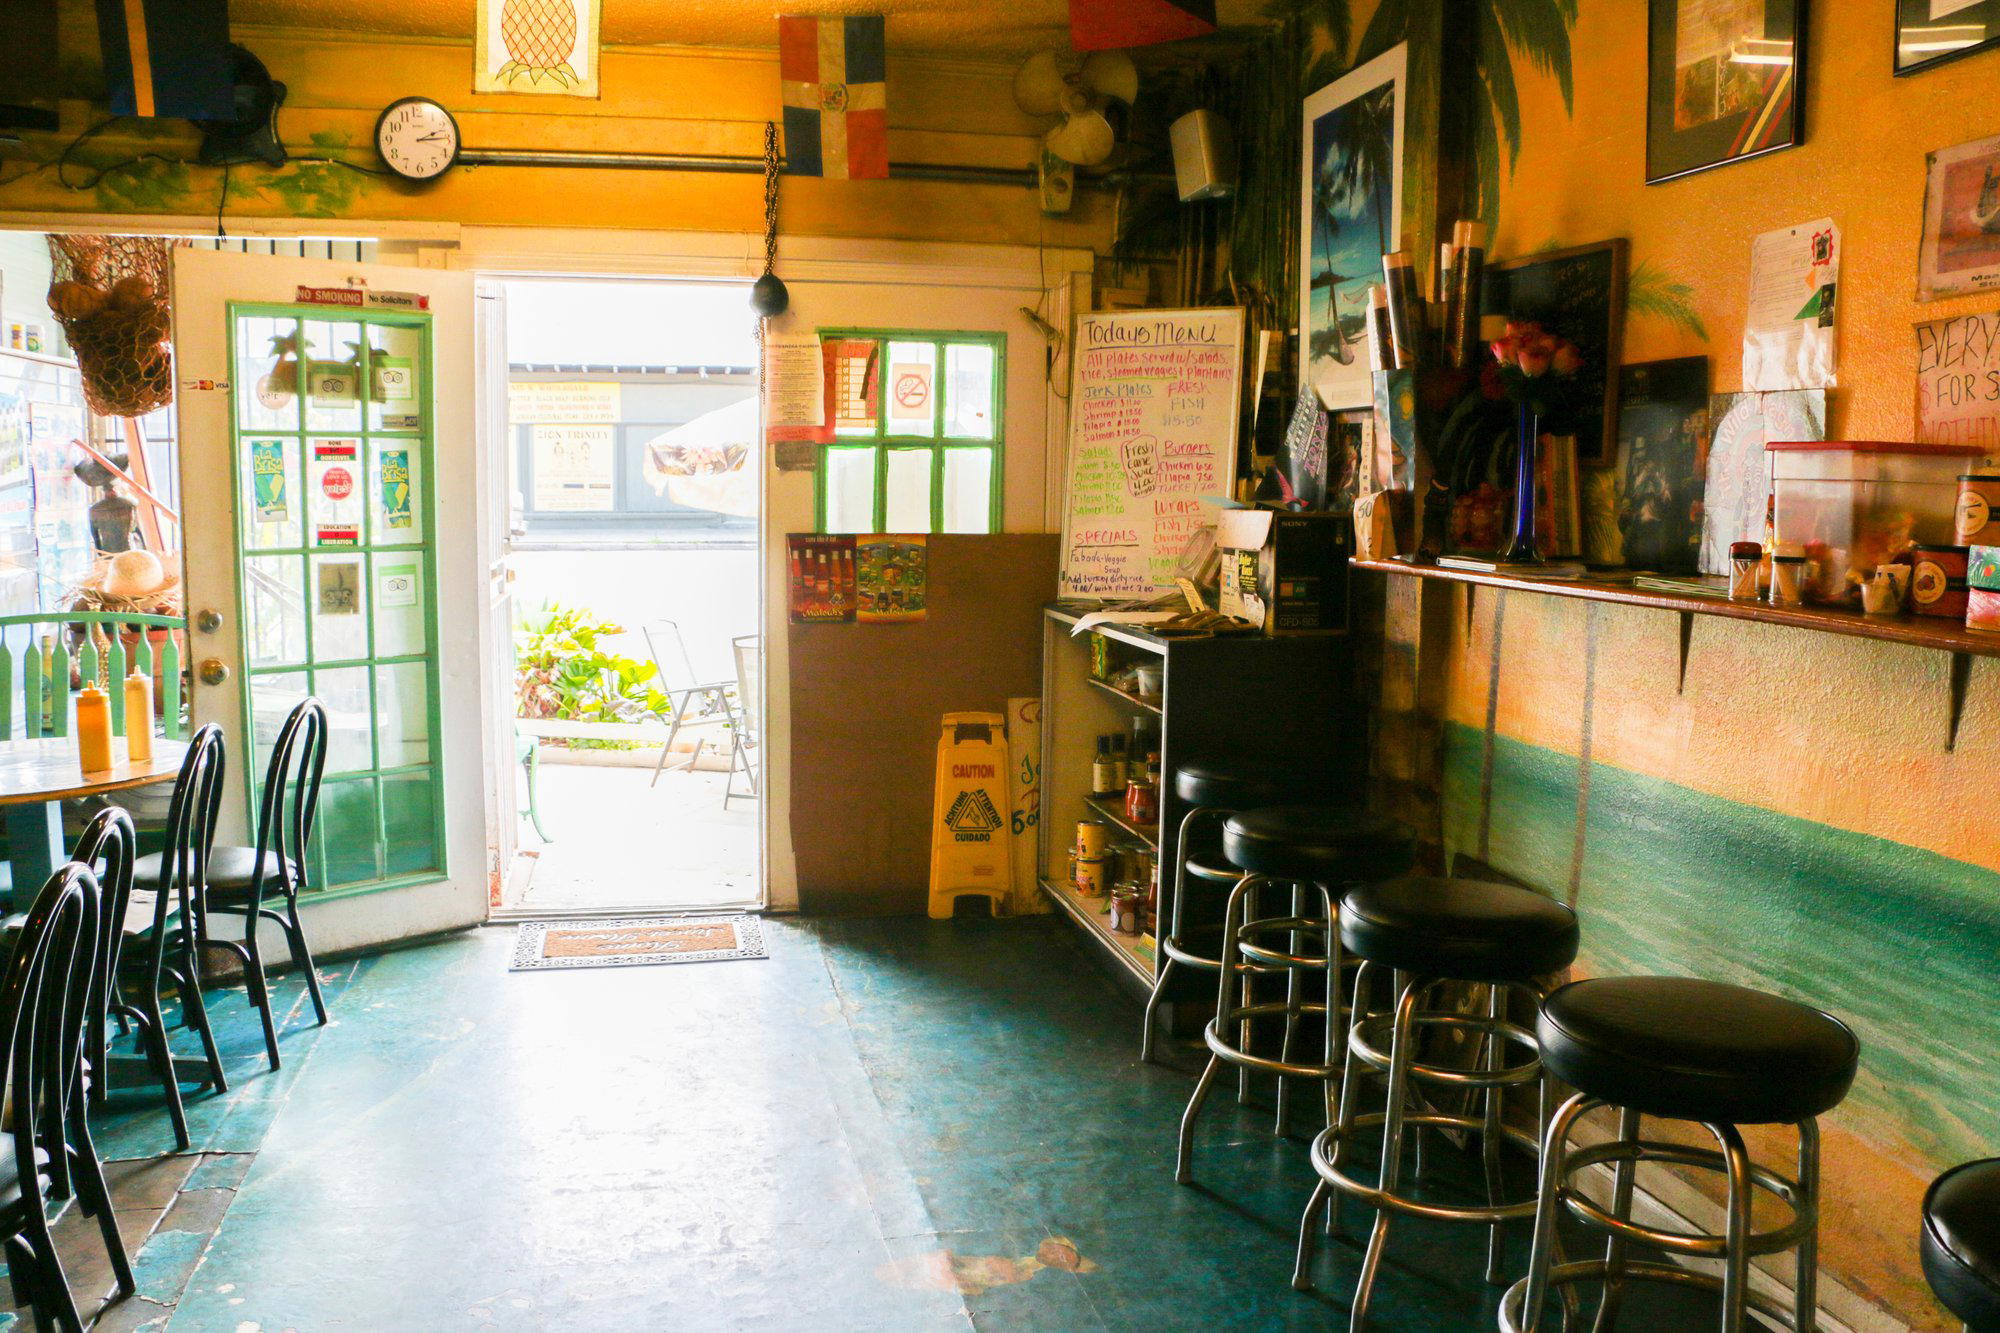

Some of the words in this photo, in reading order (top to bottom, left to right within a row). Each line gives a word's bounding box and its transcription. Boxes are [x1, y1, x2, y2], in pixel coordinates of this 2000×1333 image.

[400, 111, 409, 122] 11
[412, 106, 424, 118] 12
[390, 121, 402, 133] 10
[385, 135, 393, 145] 9
[391, 148, 398, 159] 8
[439, 148, 448, 159] 4
[403, 157, 409, 170] 7
[416, 161, 424, 175] 6
[431, 157, 438, 168] 5
[298, 289, 312, 301] NO
[315, 291, 361, 304] SMOKING
[369, 295, 380, 303] No
[380, 296, 412, 306] Solicitors
[1087, 353, 1104, 368] All
[1106, 351, 1140, 368] plates
[1937, 372, 1976, 408] FOR
[567, 430, 609, 439] TRINITY
[1075, 529, 1138, 545] SPECIALS
[952, 764, 995, 779] CAUTION
[944, 790, 969, 826] ACHTUNG
[976, 788, 1004, 829] ATTENTION
[954, 832, 991, 842] CUIDADO
